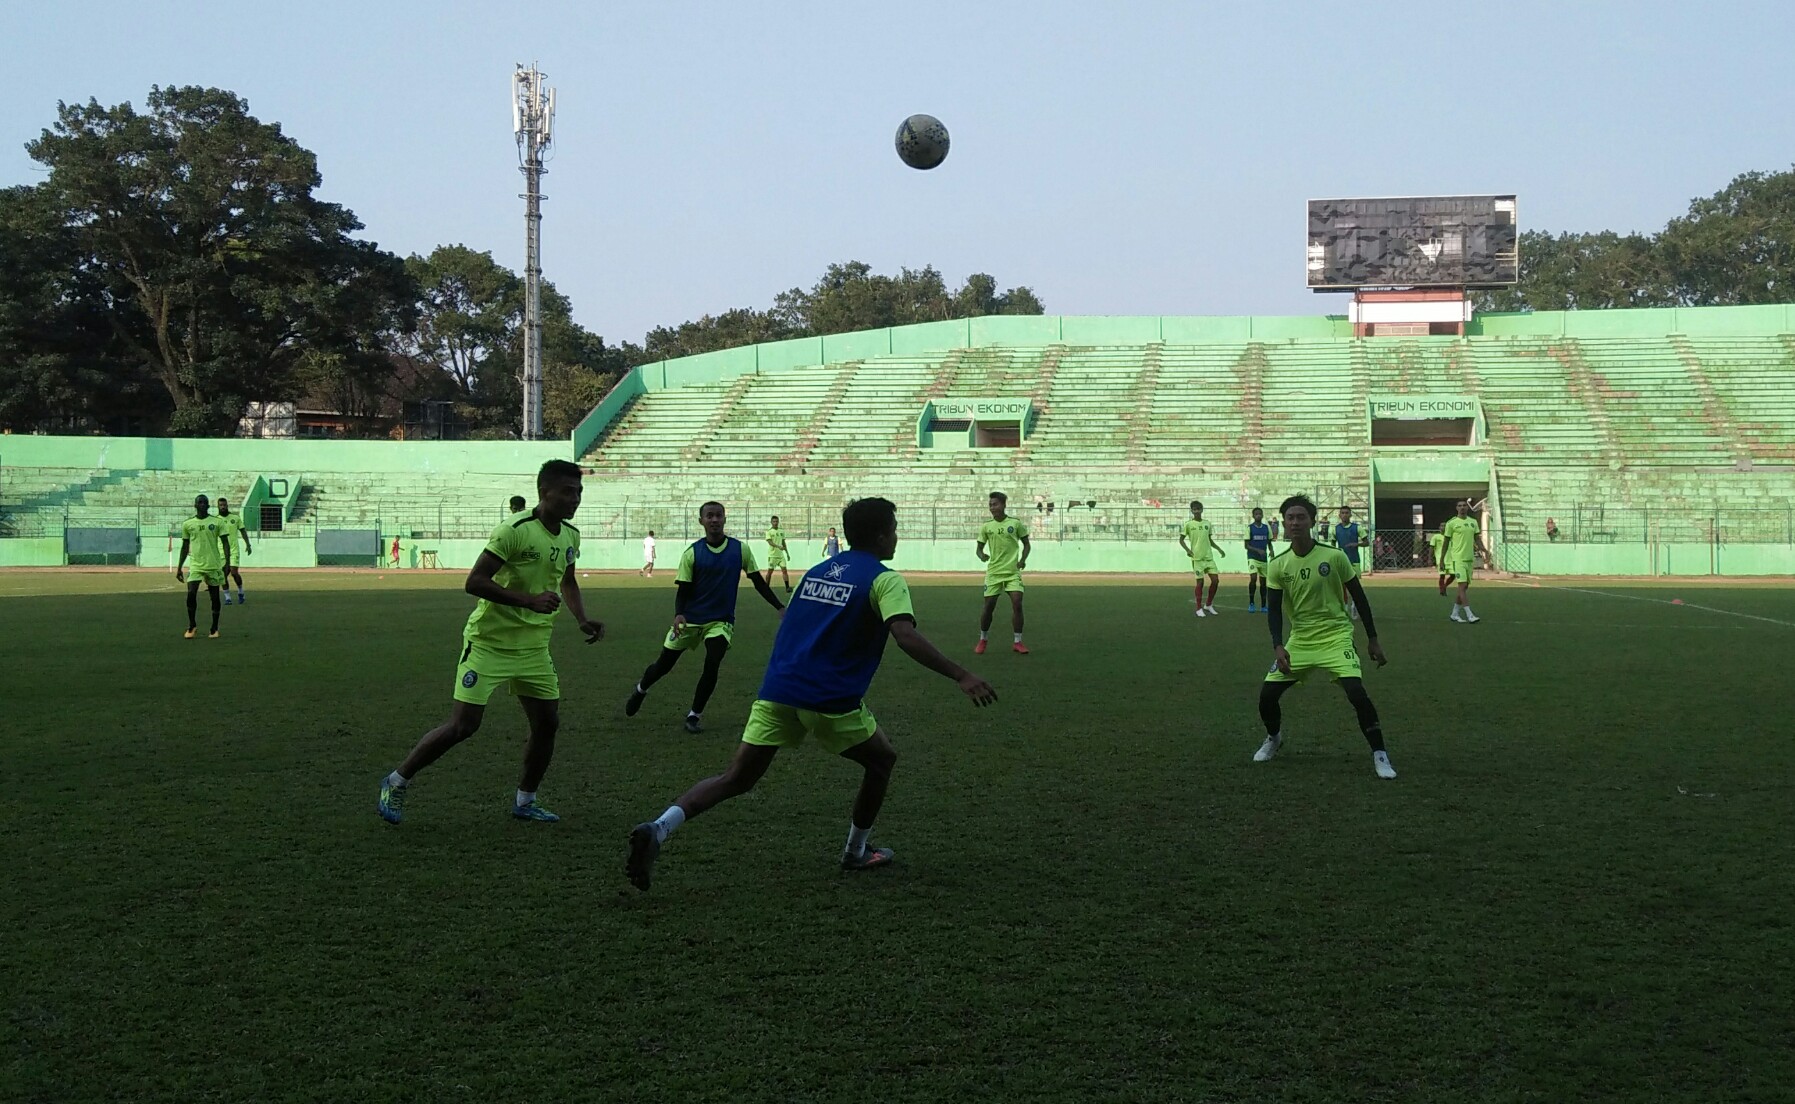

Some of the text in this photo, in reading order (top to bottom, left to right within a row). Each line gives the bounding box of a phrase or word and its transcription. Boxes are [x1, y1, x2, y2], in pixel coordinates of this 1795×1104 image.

[931, 404, 974, 414] TRIBUN
[1369, 401, 1474, 411] TRIBUN EKONOMI
[269, 479, 288, 498] D
[549, 546, 560, 561] 27
[1299, 568, 1311, 580] 87
[803, 581, 850, 602] MUNICH
[1343, 651, 1355, 660] 87
